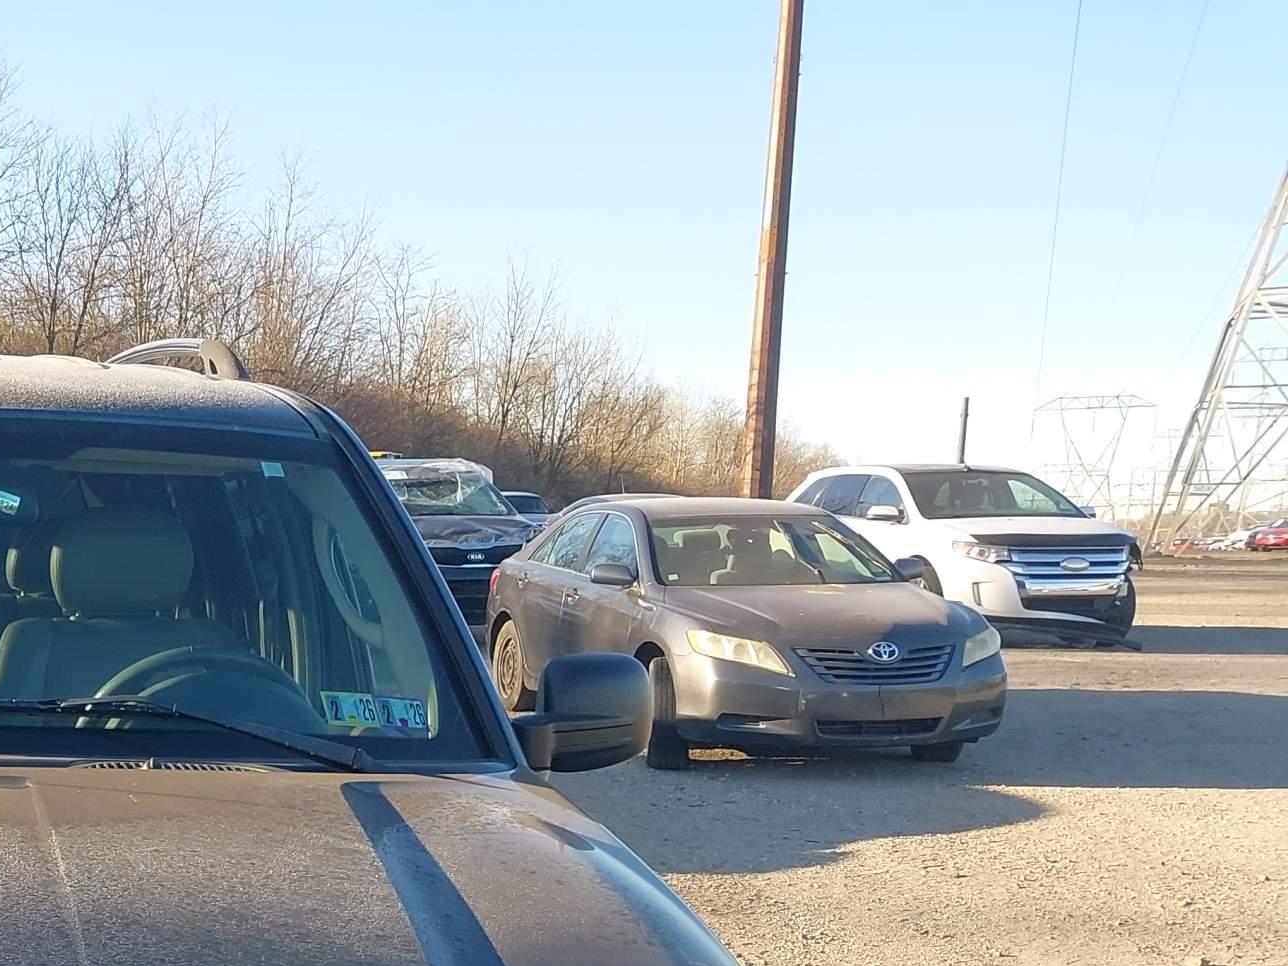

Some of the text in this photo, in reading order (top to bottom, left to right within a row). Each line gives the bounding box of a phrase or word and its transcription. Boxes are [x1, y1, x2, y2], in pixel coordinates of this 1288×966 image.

[330, 698, 376, 721] 2 26
[382, 703, 426, 726] 2 26
